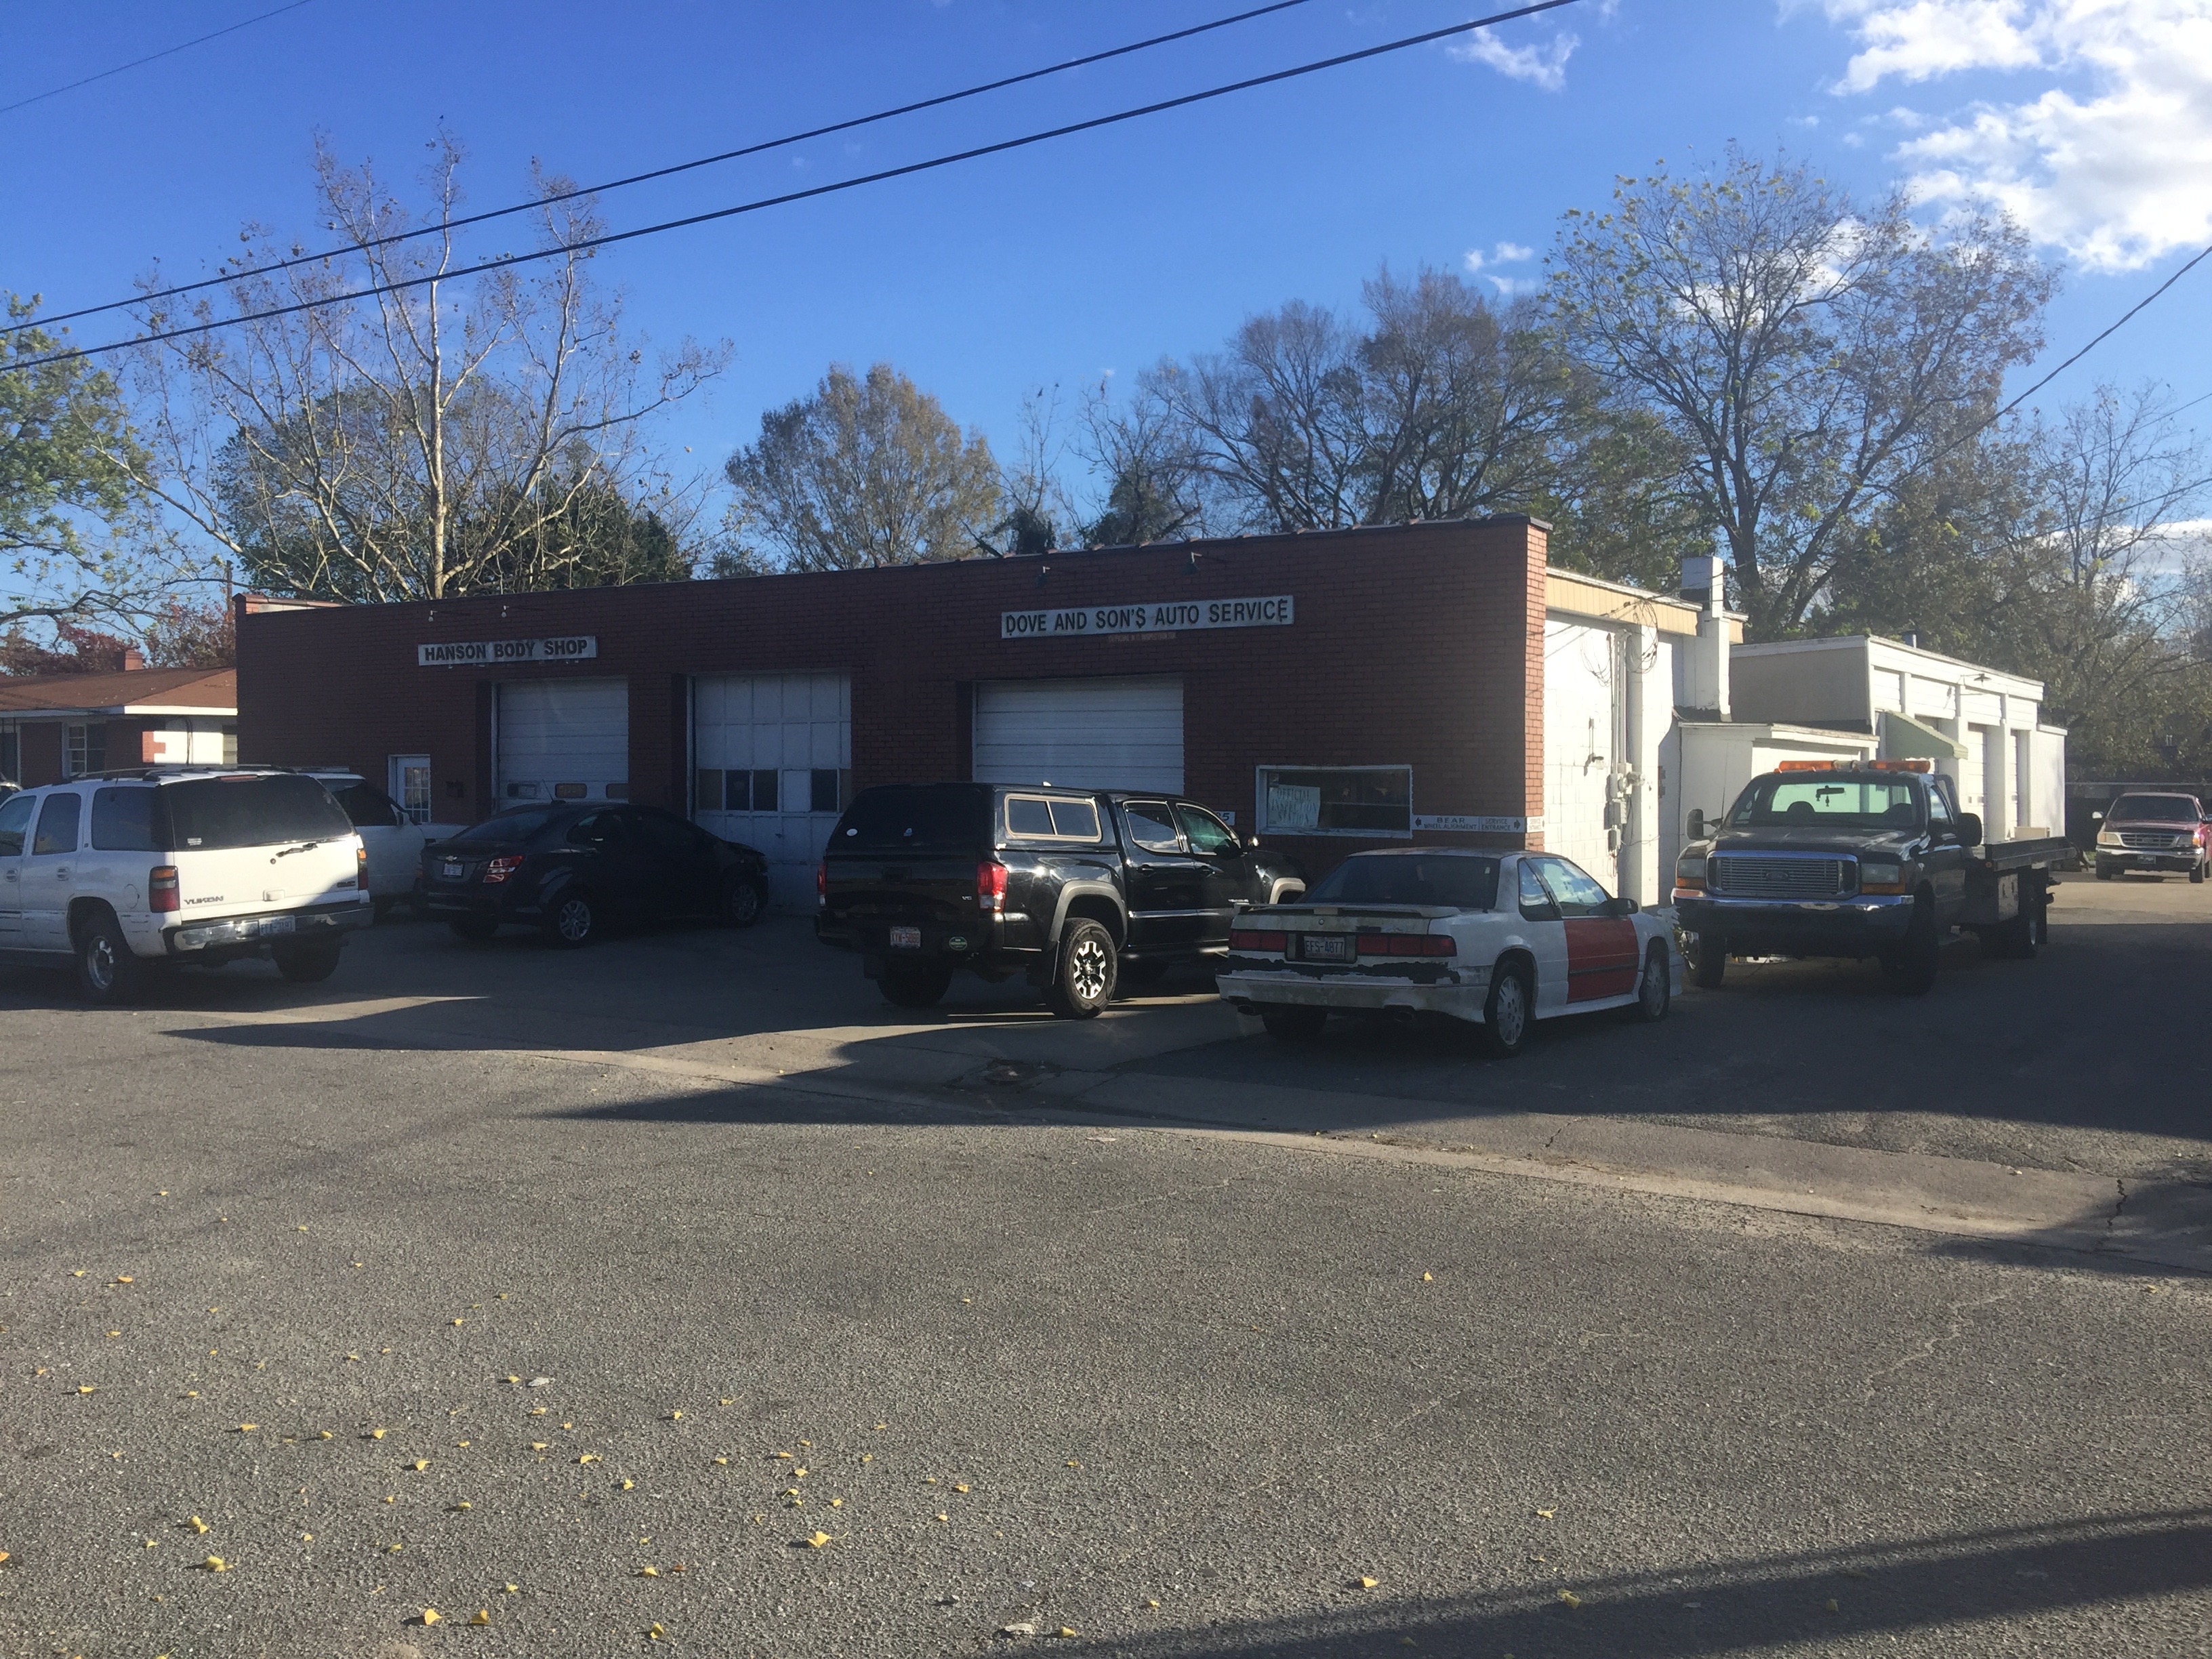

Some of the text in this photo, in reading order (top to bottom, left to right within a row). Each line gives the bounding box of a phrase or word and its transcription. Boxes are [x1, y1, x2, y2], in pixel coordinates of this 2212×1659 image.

[1006, 600, 1288, 634] DOVE AND SON'S AUTO SERVICE
[424, 639, 588, 661] HANSON BODY SHOP
[184, 895, 224, 905] YUKON
